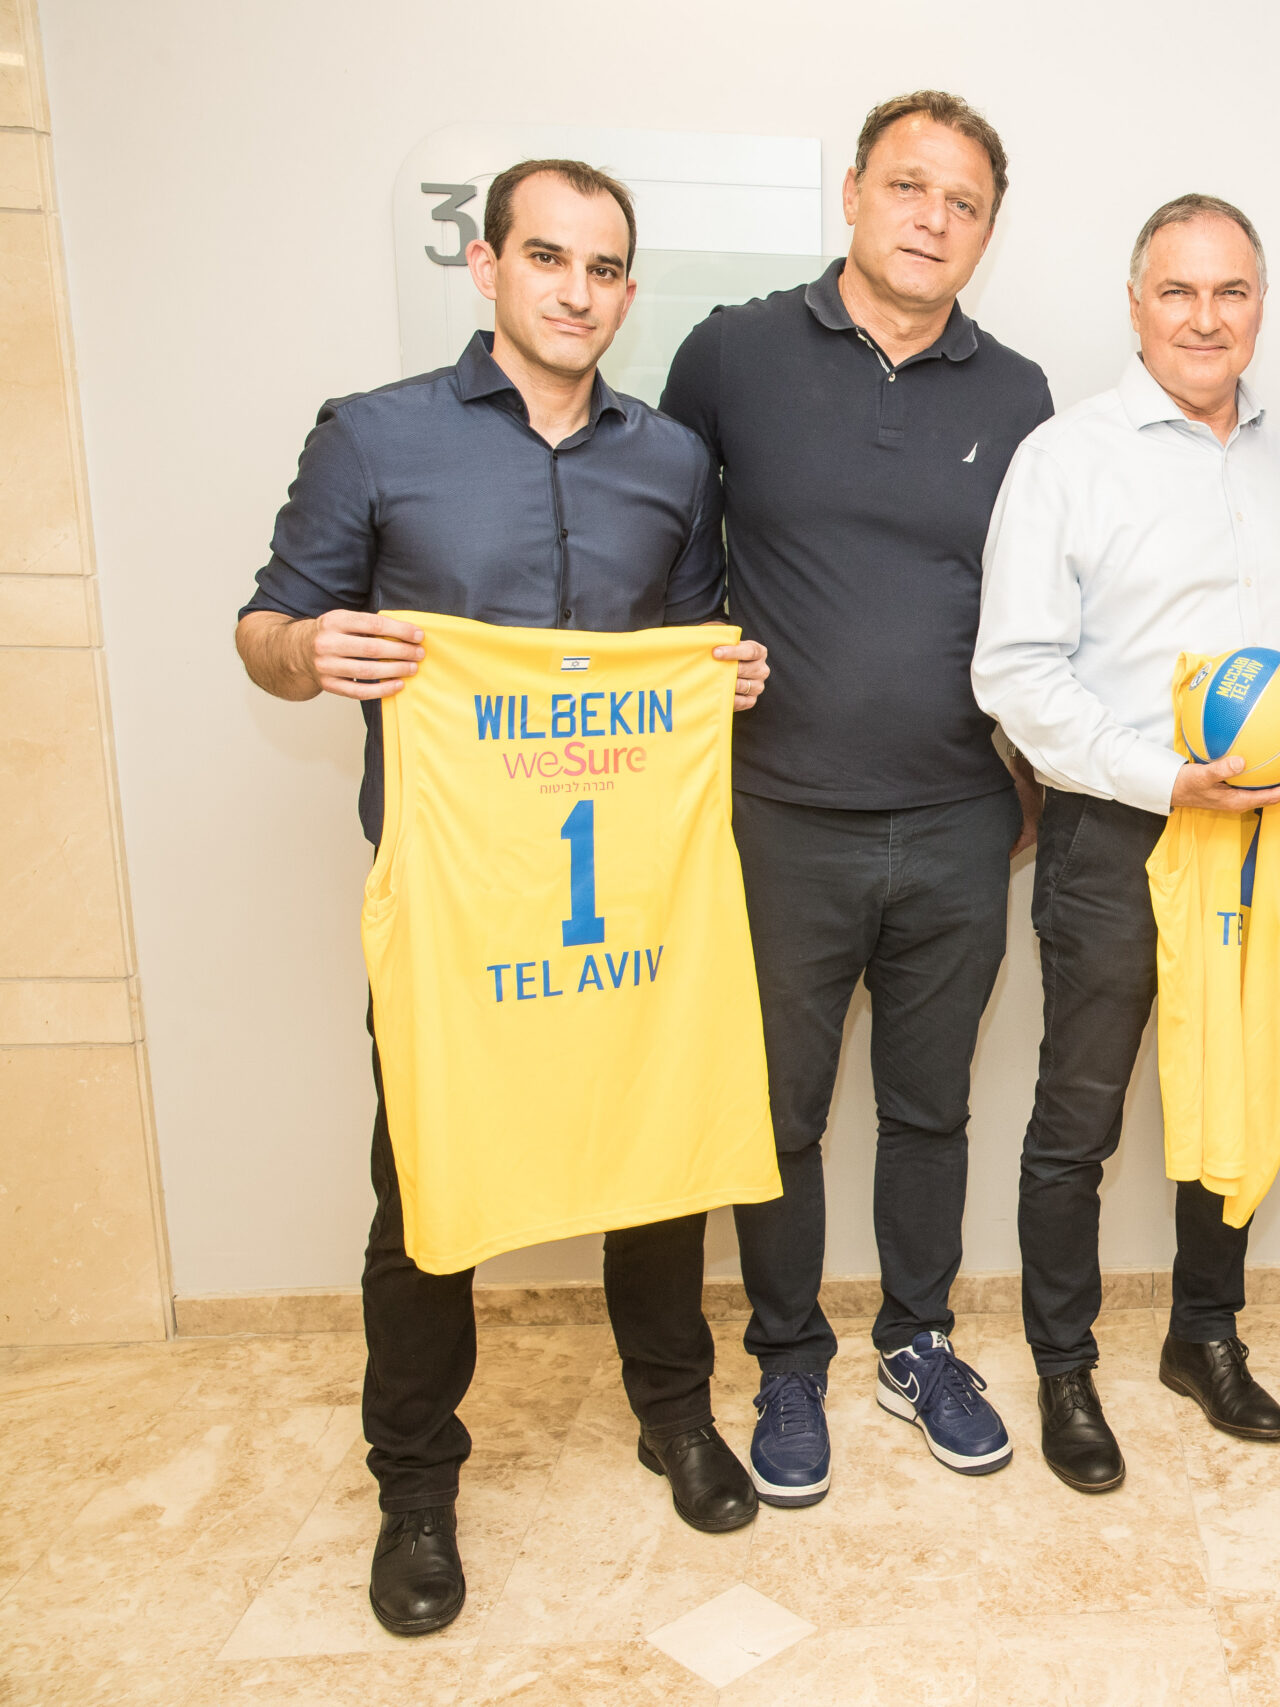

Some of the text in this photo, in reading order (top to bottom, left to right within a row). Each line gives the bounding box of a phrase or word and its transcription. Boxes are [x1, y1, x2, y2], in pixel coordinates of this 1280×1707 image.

[421, 182, 478, 266] 3
[1216, 656, 1251, 698] MACCABI
[1229, 659, 1264, 701] TEL-AVIV
[474, 689, 673, 741] WILBEKIN
[502, 741, 647, 779] weSure
[540, 781, 614, 794] חברה לביטוח
[560, 800, 605, 947] 1
[487, 945, 664, 1003] TEL AVIV
